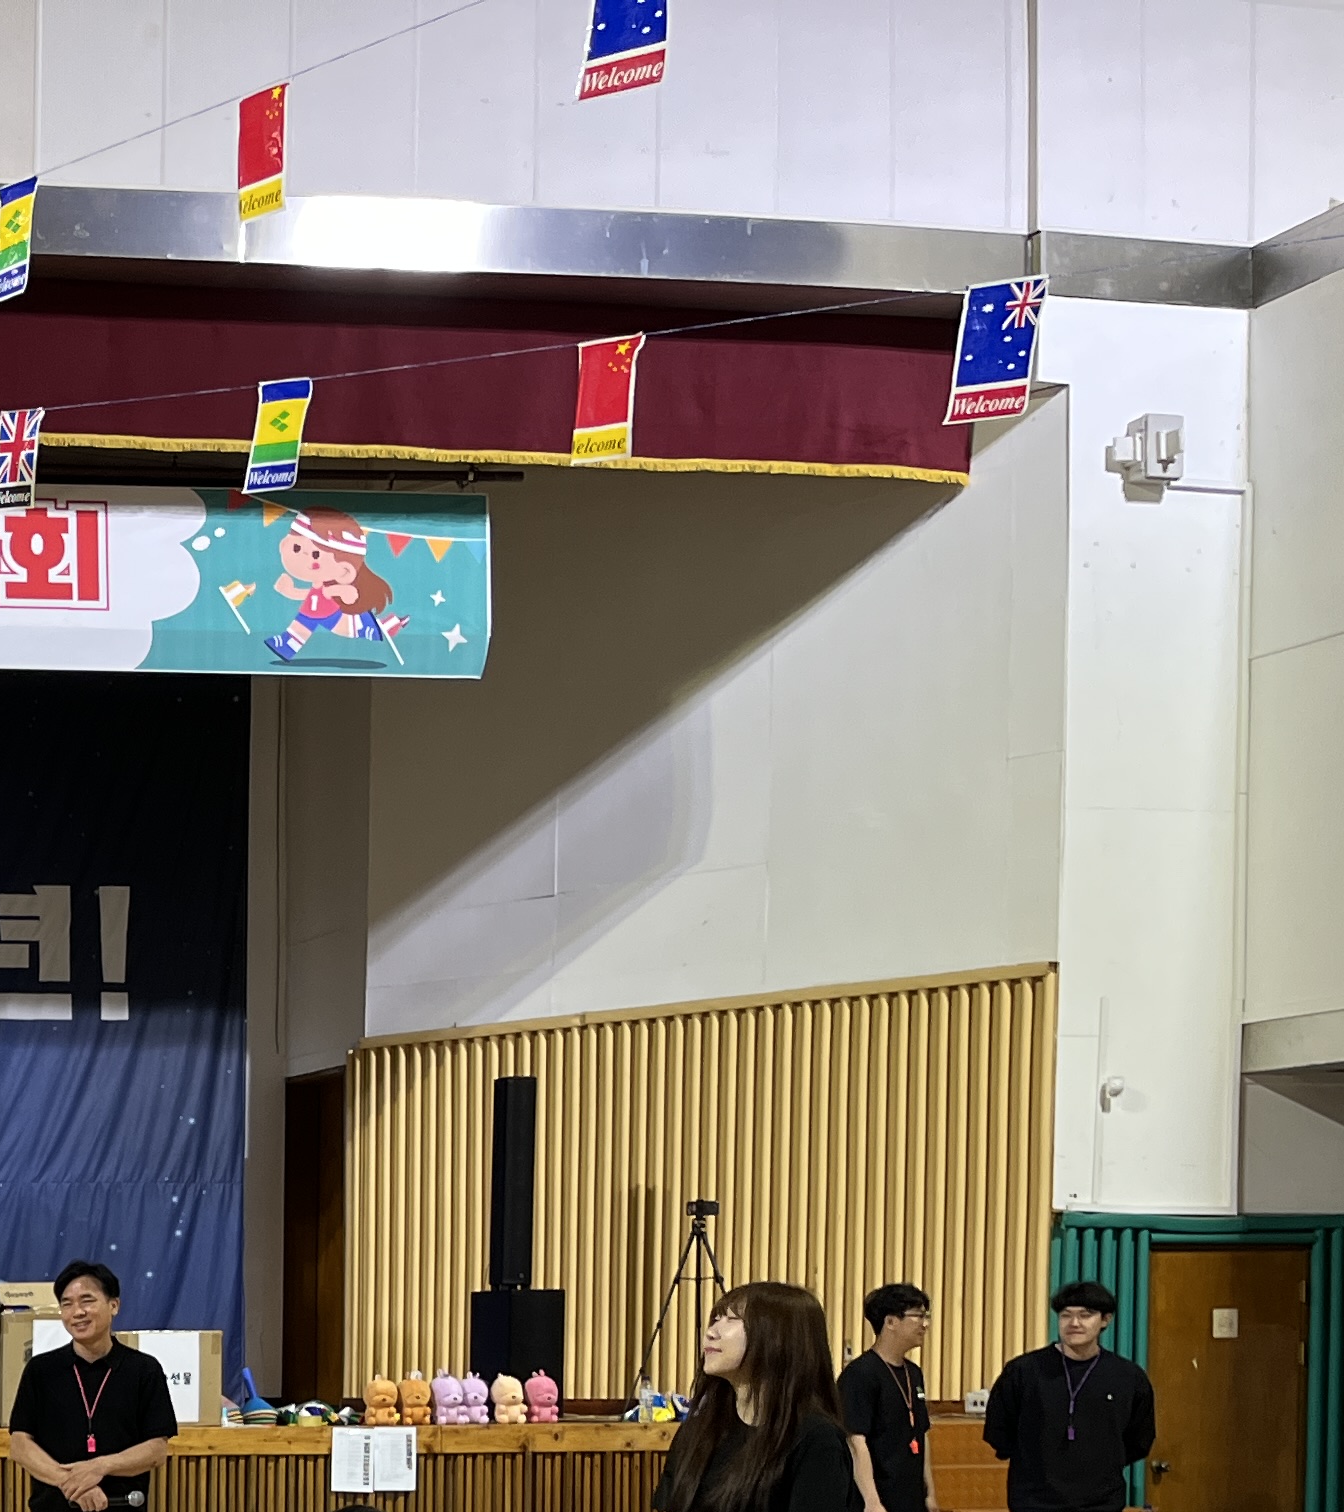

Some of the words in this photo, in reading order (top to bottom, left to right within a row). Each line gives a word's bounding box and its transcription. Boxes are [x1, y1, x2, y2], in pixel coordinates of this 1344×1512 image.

[583, 60, 664, 90] Welcome
[953, 391, 1024, 411] Welcome
[249, 471, 296, 485] Welcome
